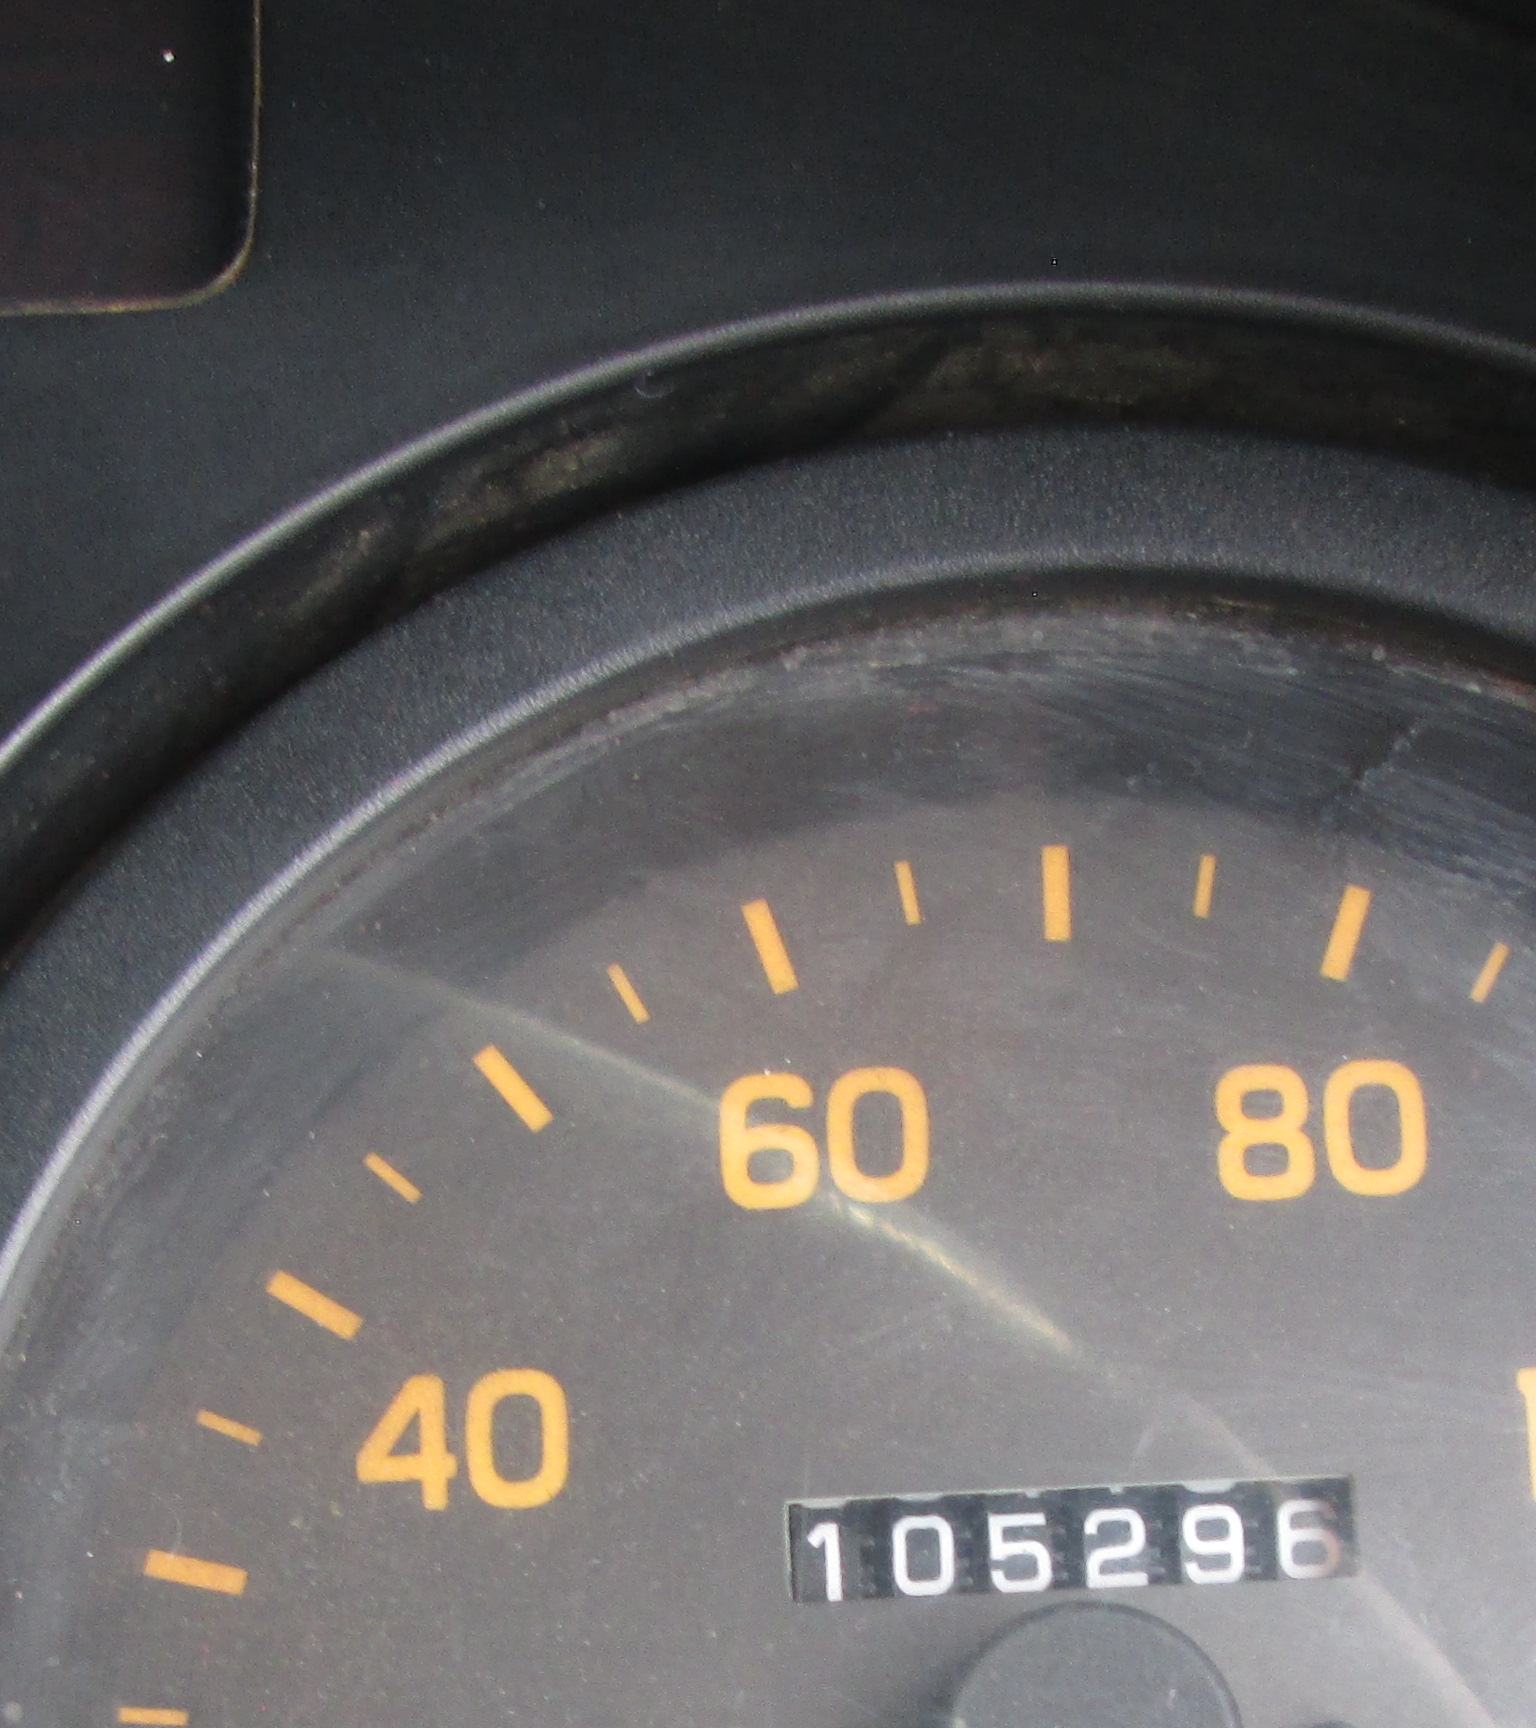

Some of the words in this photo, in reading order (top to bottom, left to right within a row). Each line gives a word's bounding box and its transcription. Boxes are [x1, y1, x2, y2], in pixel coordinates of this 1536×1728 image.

[719, 1065, 931, 1211] 60
[1215, 1060, 1428, 1201] 80
[356, 1367, 571, 1510] 40
[807, 1499, 1342, 1602] 105296
